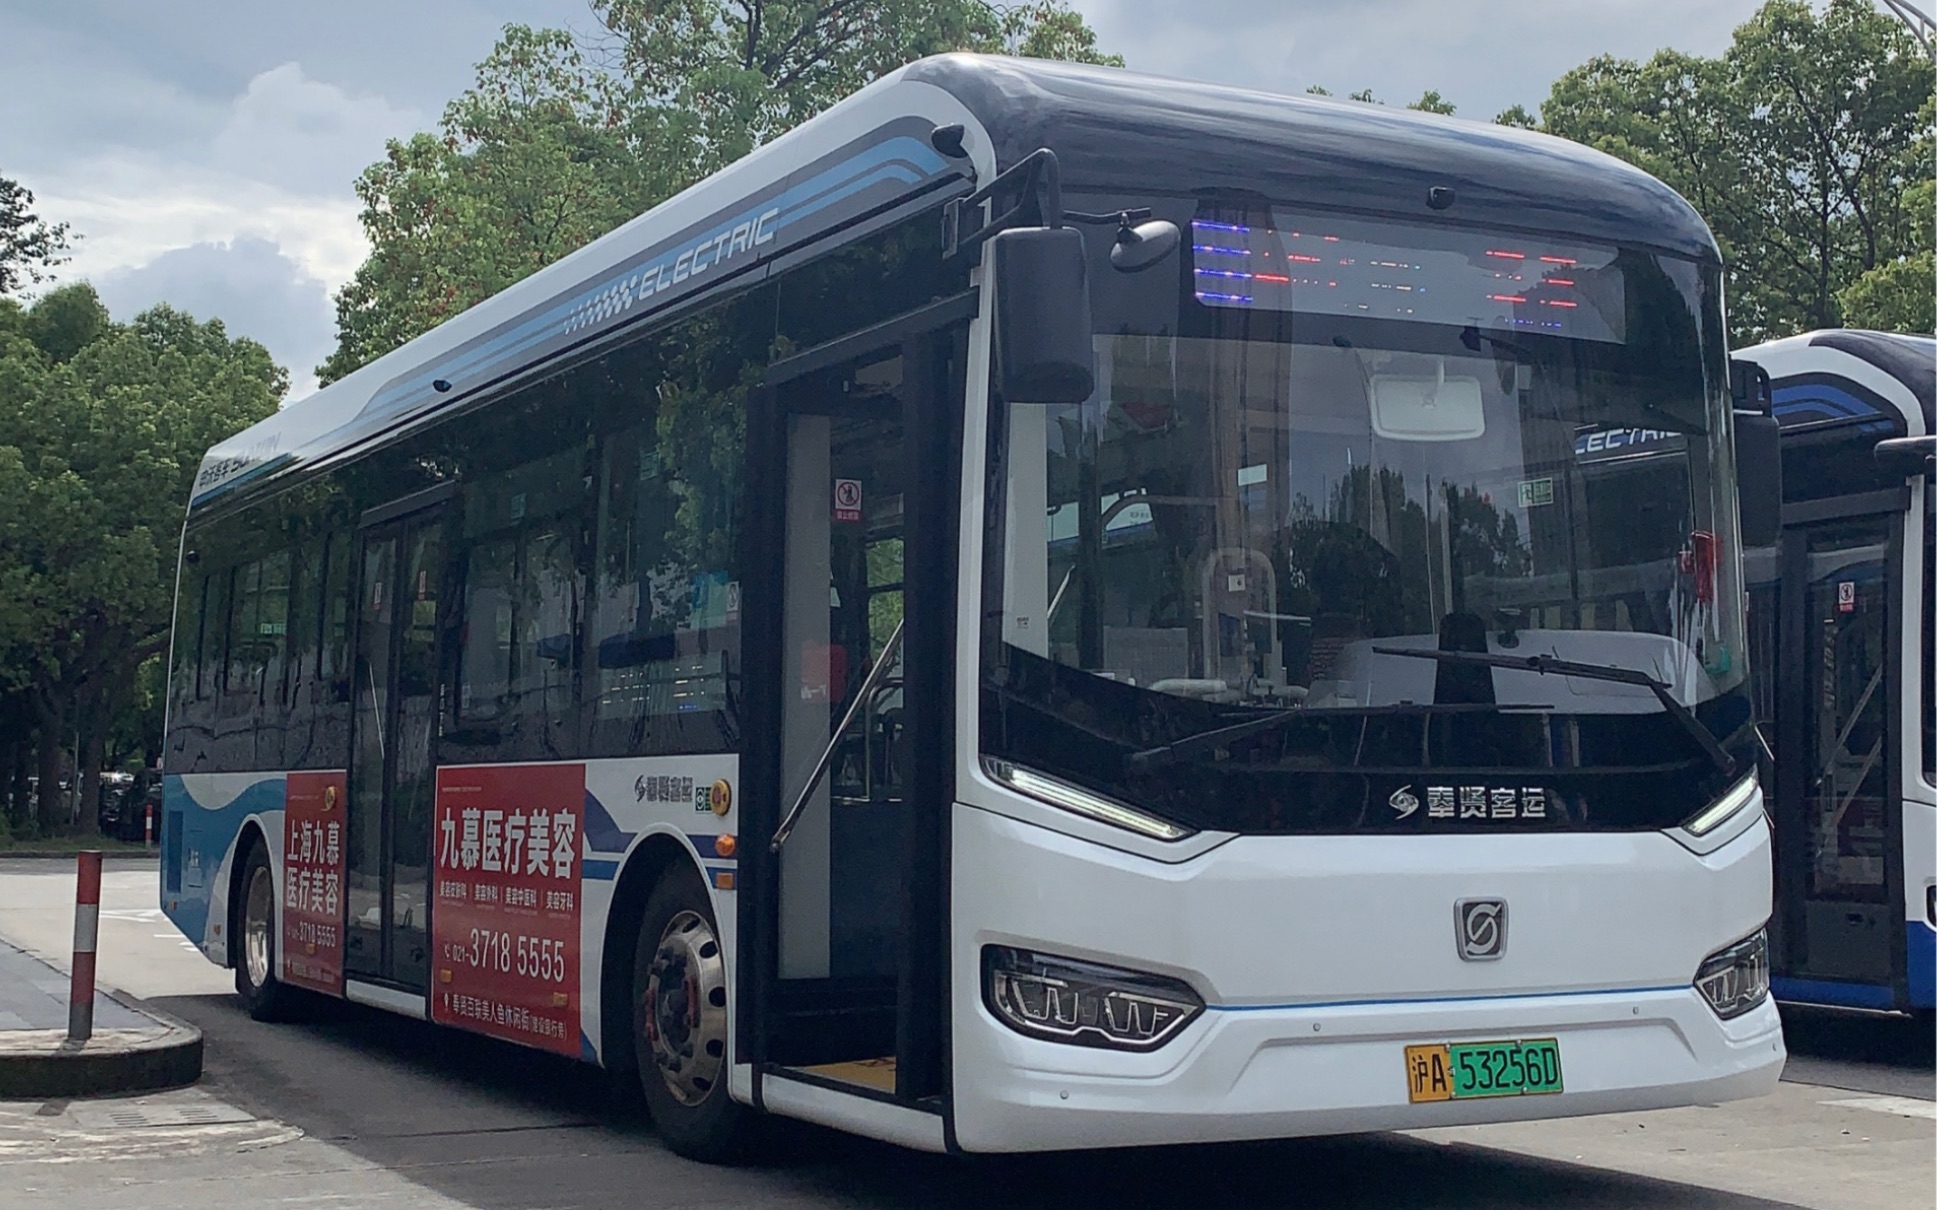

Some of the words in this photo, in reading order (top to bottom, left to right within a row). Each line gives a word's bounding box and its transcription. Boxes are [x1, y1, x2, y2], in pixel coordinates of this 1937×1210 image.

[638, 207, 779, 300] ELECTRIC
[1426, 785, 1546, 818] 奉贤客运
[287, 819, 340, 866] 上海九慕
[440, 806, 576, 879] 九慕医疗美容
[286, 866, 338, 916] 医疗美容
[452, 928, 510, 972] 021-3718
[517, 935, 564, 982] 5555
[1459, 1047, 1559, 1090] 53256D
